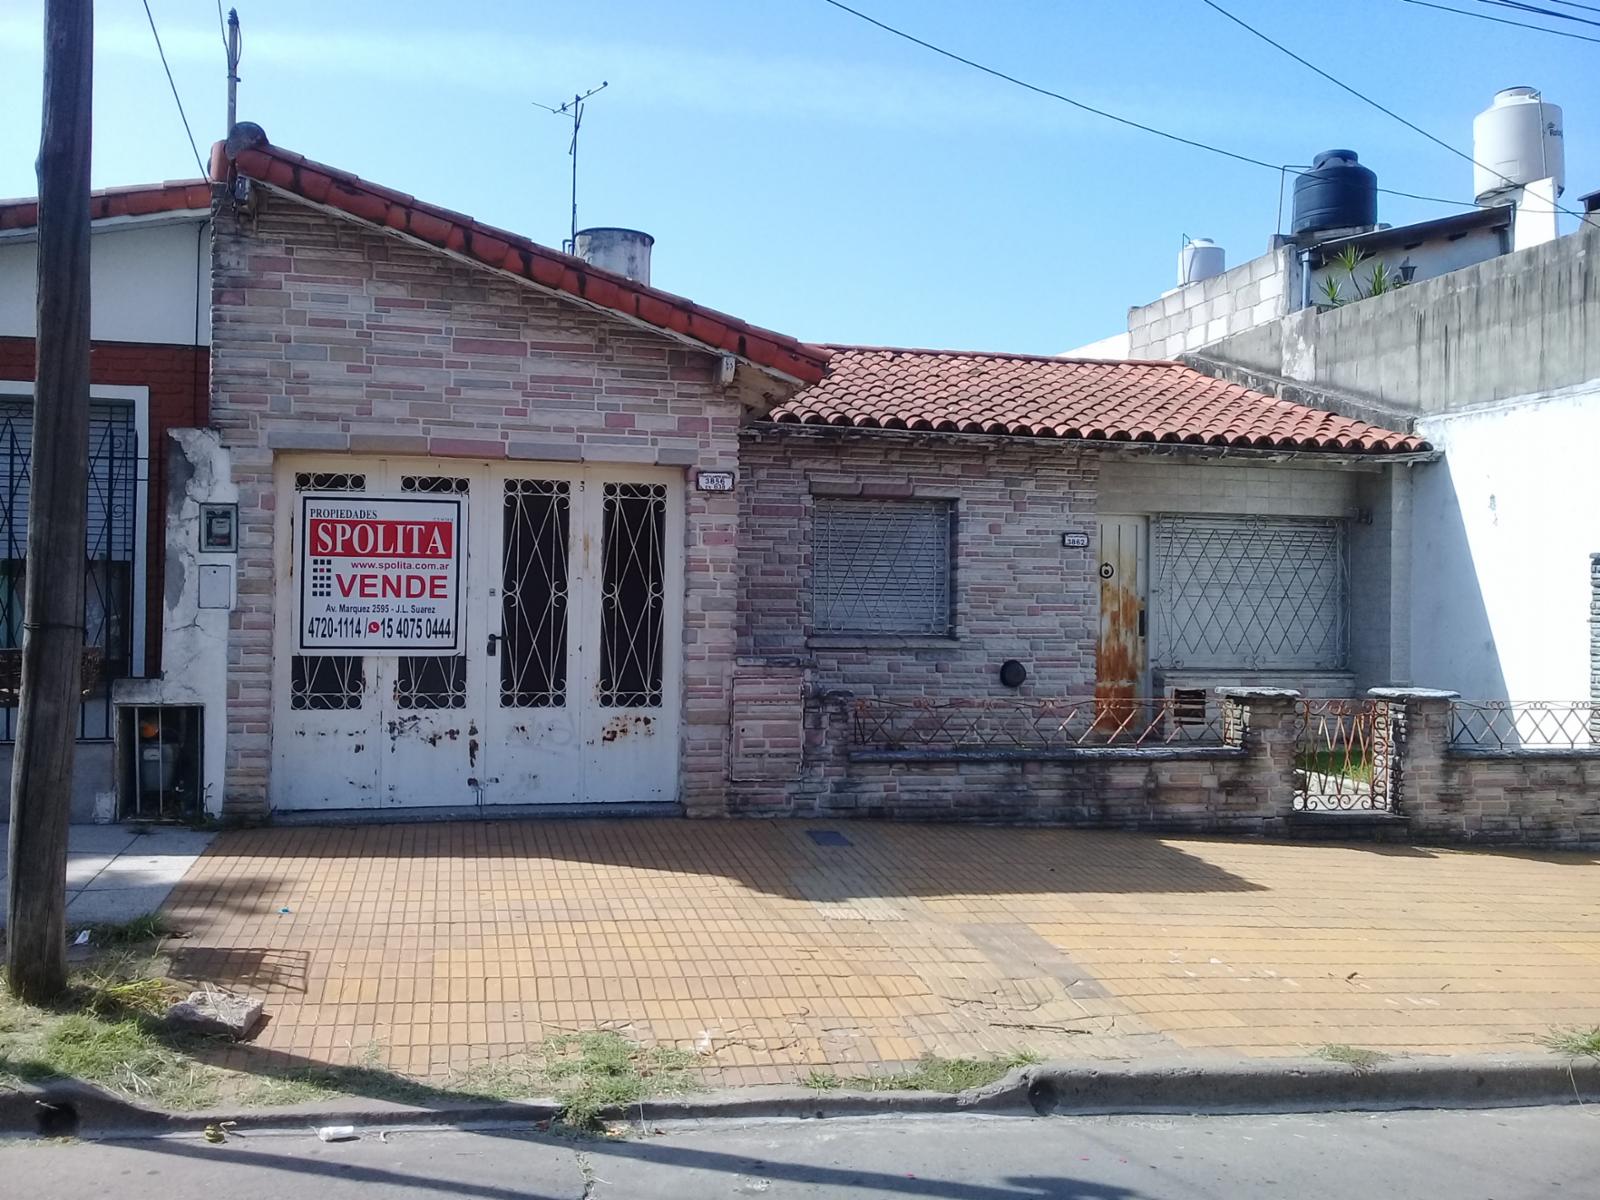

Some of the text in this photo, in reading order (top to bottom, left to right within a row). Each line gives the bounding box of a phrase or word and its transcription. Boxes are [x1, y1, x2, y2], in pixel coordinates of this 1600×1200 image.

[310, 508, 378, 519] PROPIEDADES
[317, 522, 447, 555] SPOLITA
[351, 561, 450, 571] www.spolita.com.ar
[335, 573, 448, 599] VENDE
[325, 603, 337, 613] Av.
[338, 604, 370, 614] Marquez
[372, 604, 390, 613] 2595
[395, 604, 409, 613] J.L.
[410, 604, 436, 614] Suarez
[308, 617, 361, 639] 4720-1114
[380, 618, 393, 639] 15
[396, 618, 423, 639] 4075
[425, 618, 452, 639] 0444
